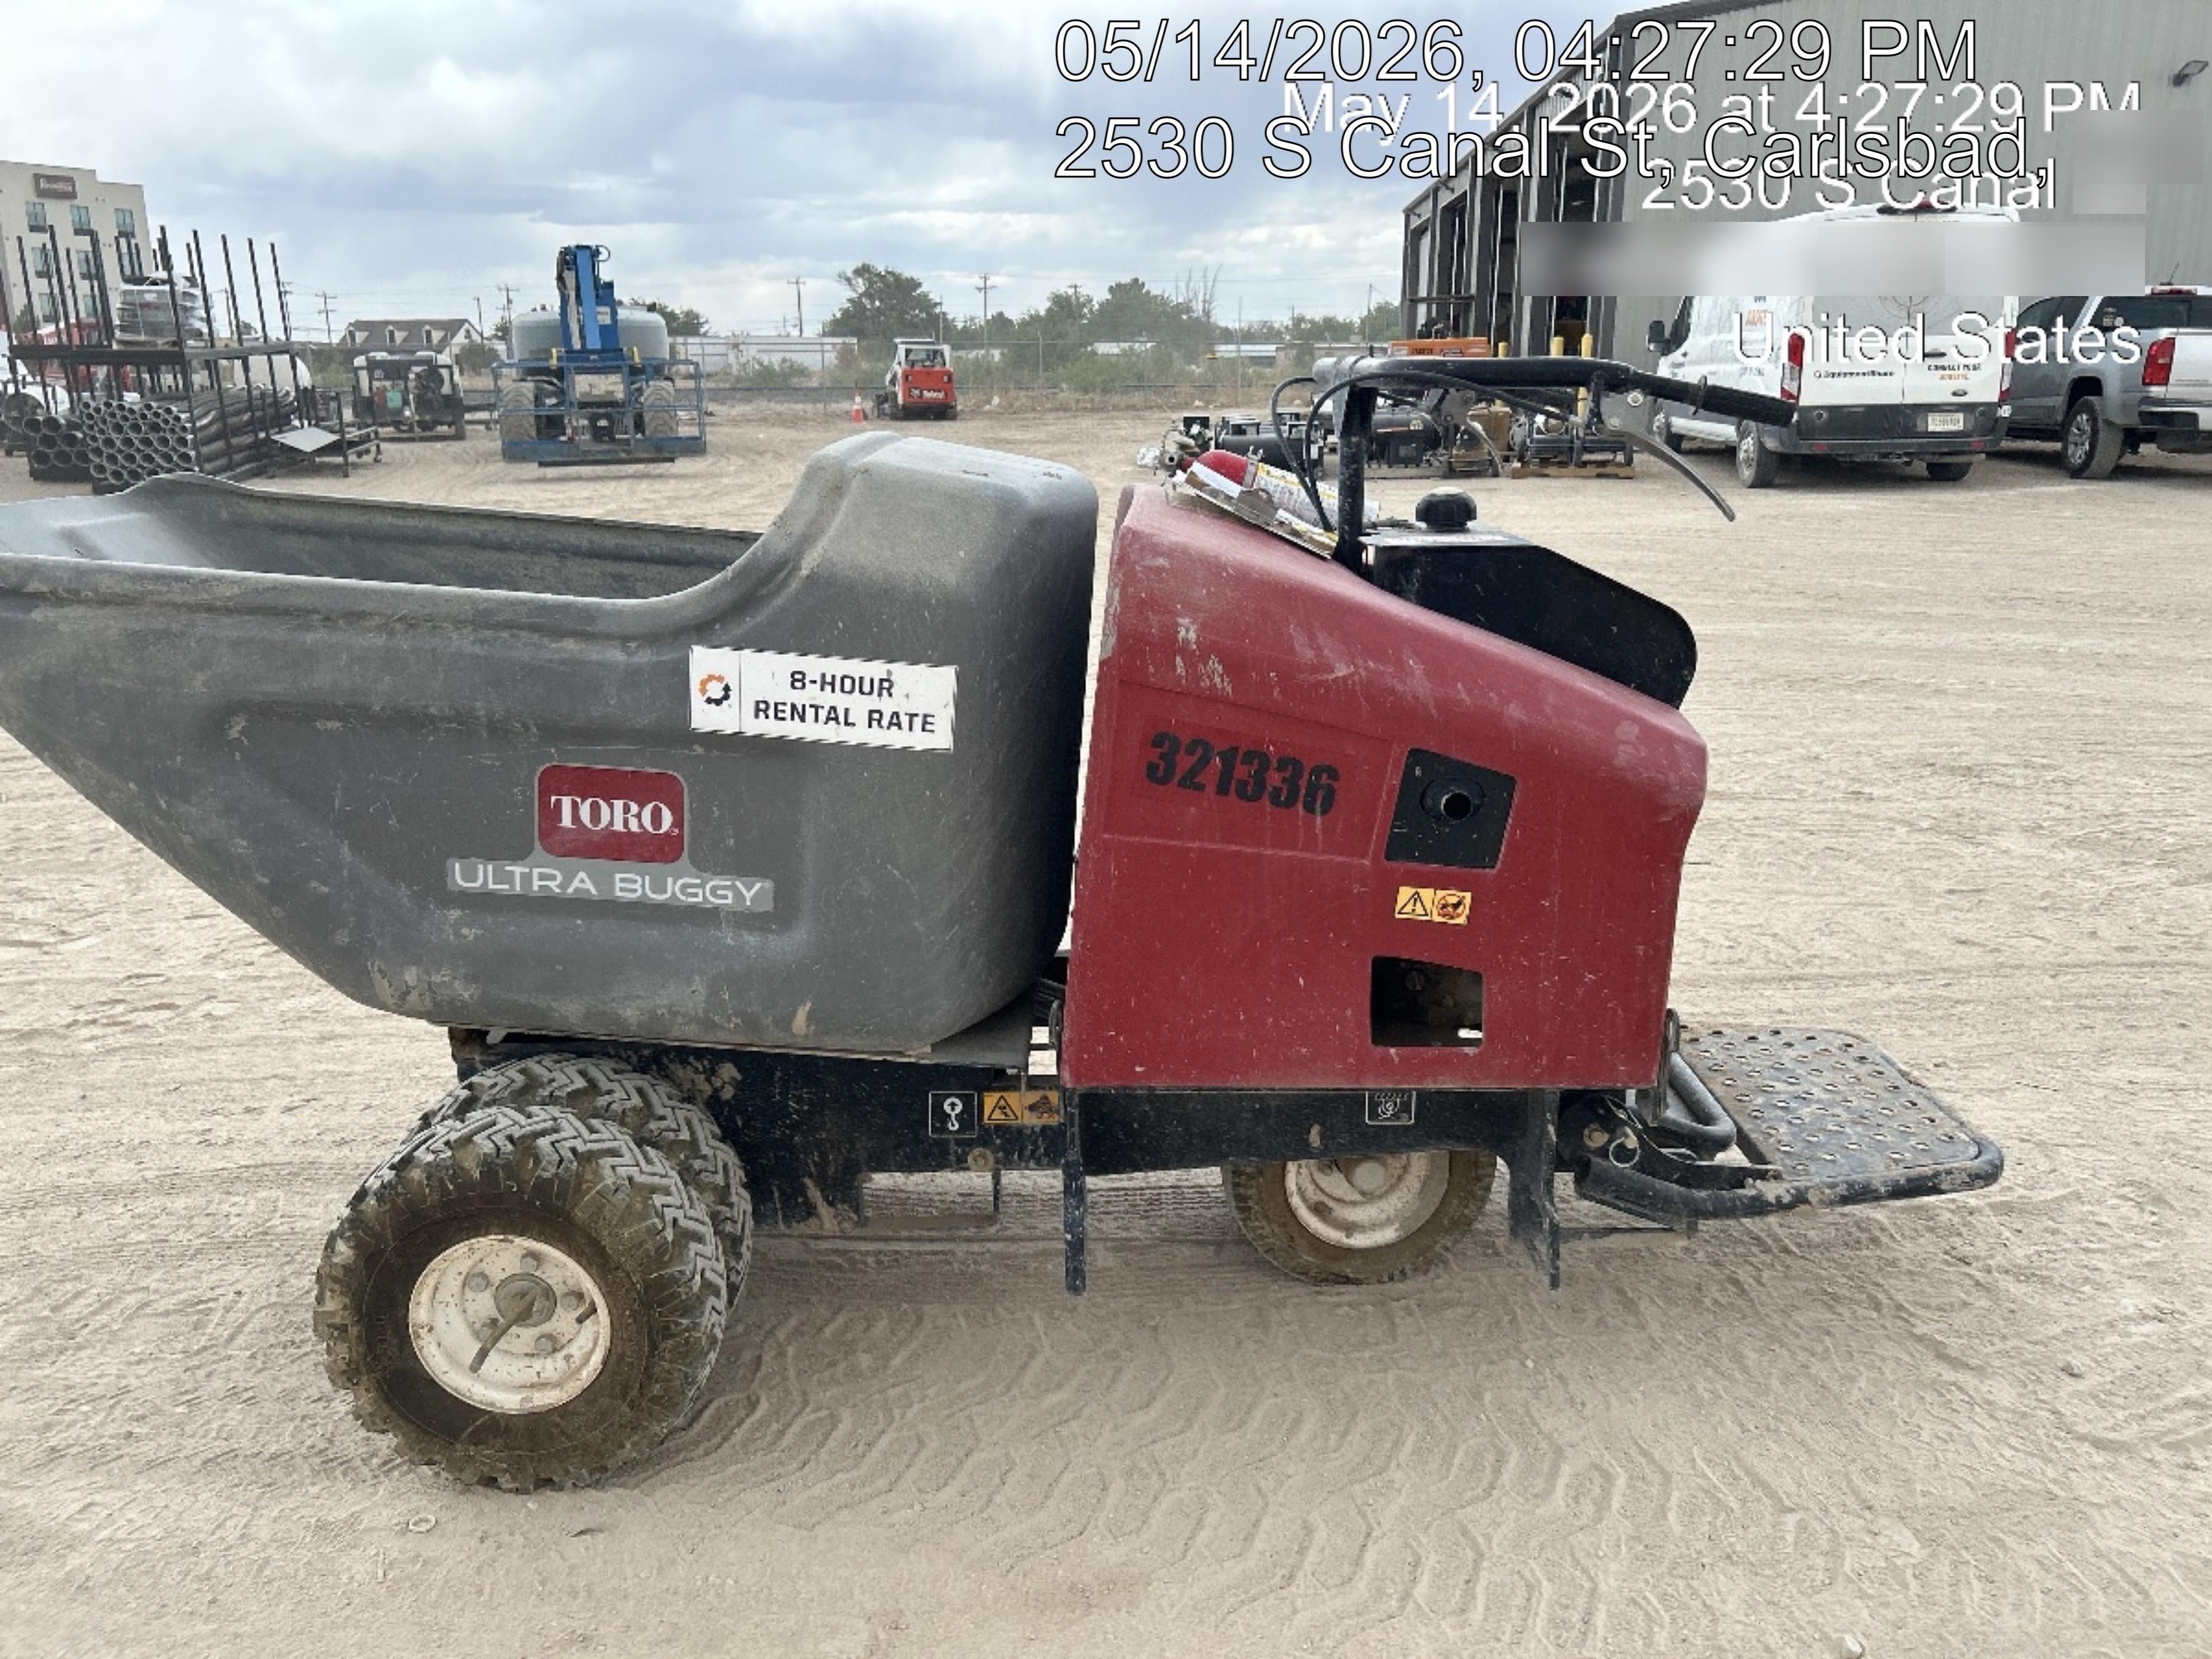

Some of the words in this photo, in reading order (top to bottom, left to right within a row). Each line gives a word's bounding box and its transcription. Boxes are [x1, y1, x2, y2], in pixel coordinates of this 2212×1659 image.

[790, 670, 894, 697] 8-HOUR
[753, 699, 857, 727] RENTAL
[867, 708, 936, 733] RATE
[1145, 731, 1341, 817] 321336
[455, 862, 598, 895] ULTRA
[614, 873, 763, 906] BUGGY
